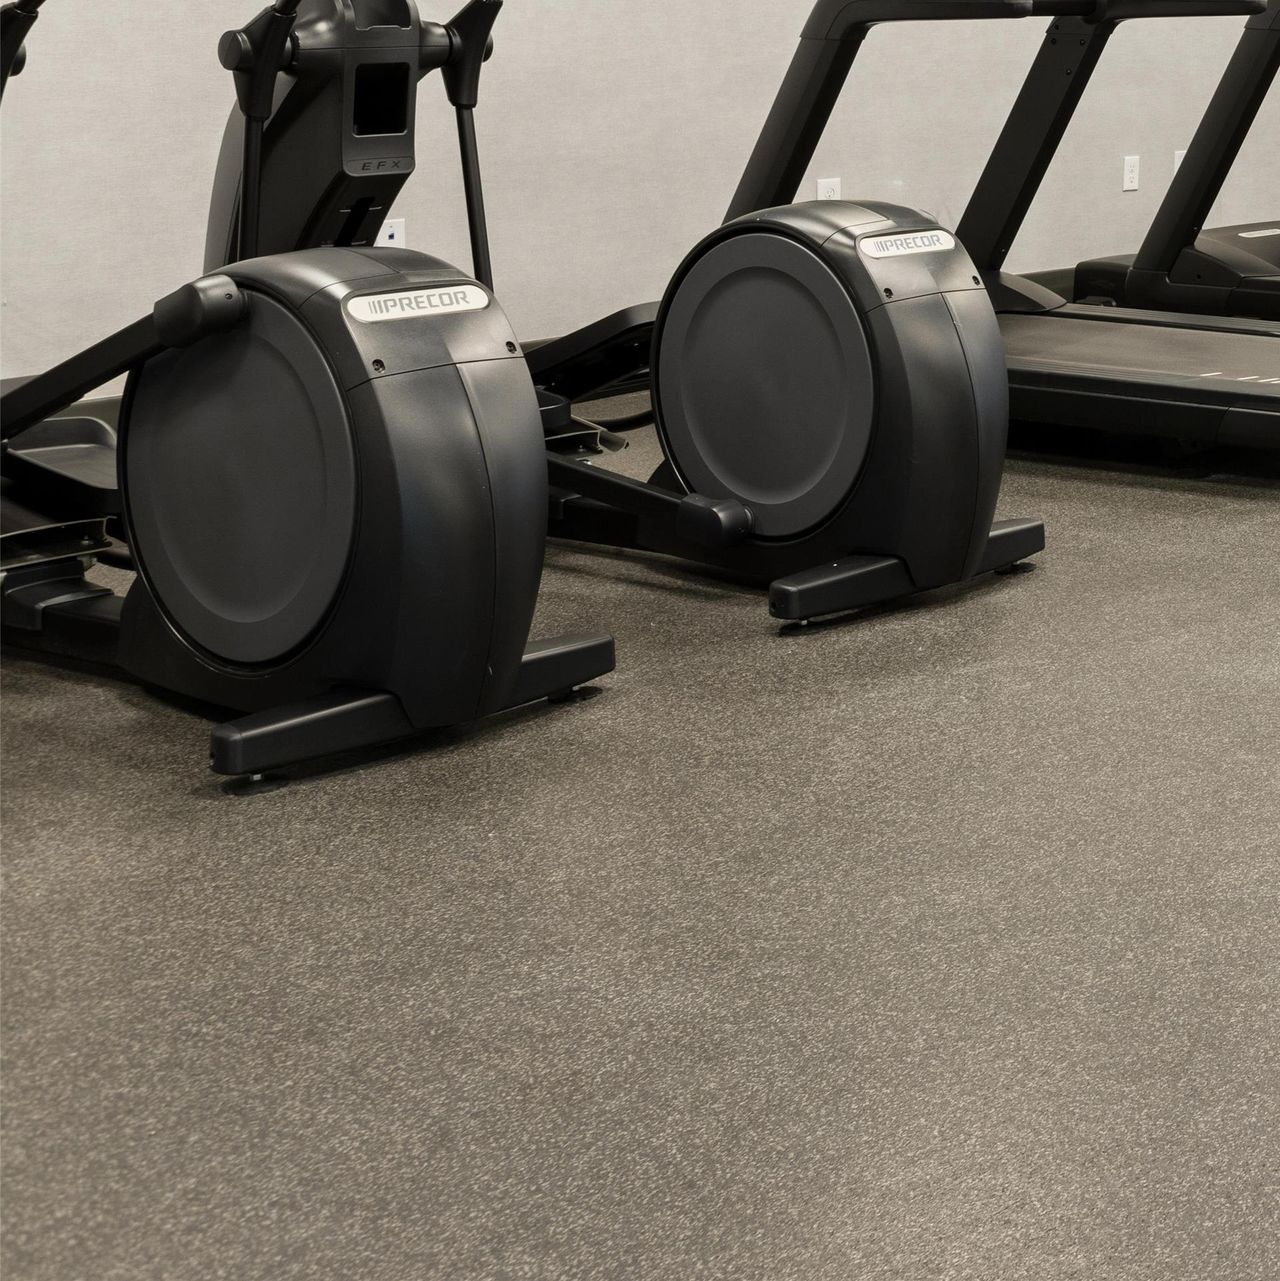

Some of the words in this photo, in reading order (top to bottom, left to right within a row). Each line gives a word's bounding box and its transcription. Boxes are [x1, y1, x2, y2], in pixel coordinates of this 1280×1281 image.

[361, 160, 401, 171] EFX
[882, 234, 943, 252] PRECOR
[382, 290, 470, 313] PRECOR
